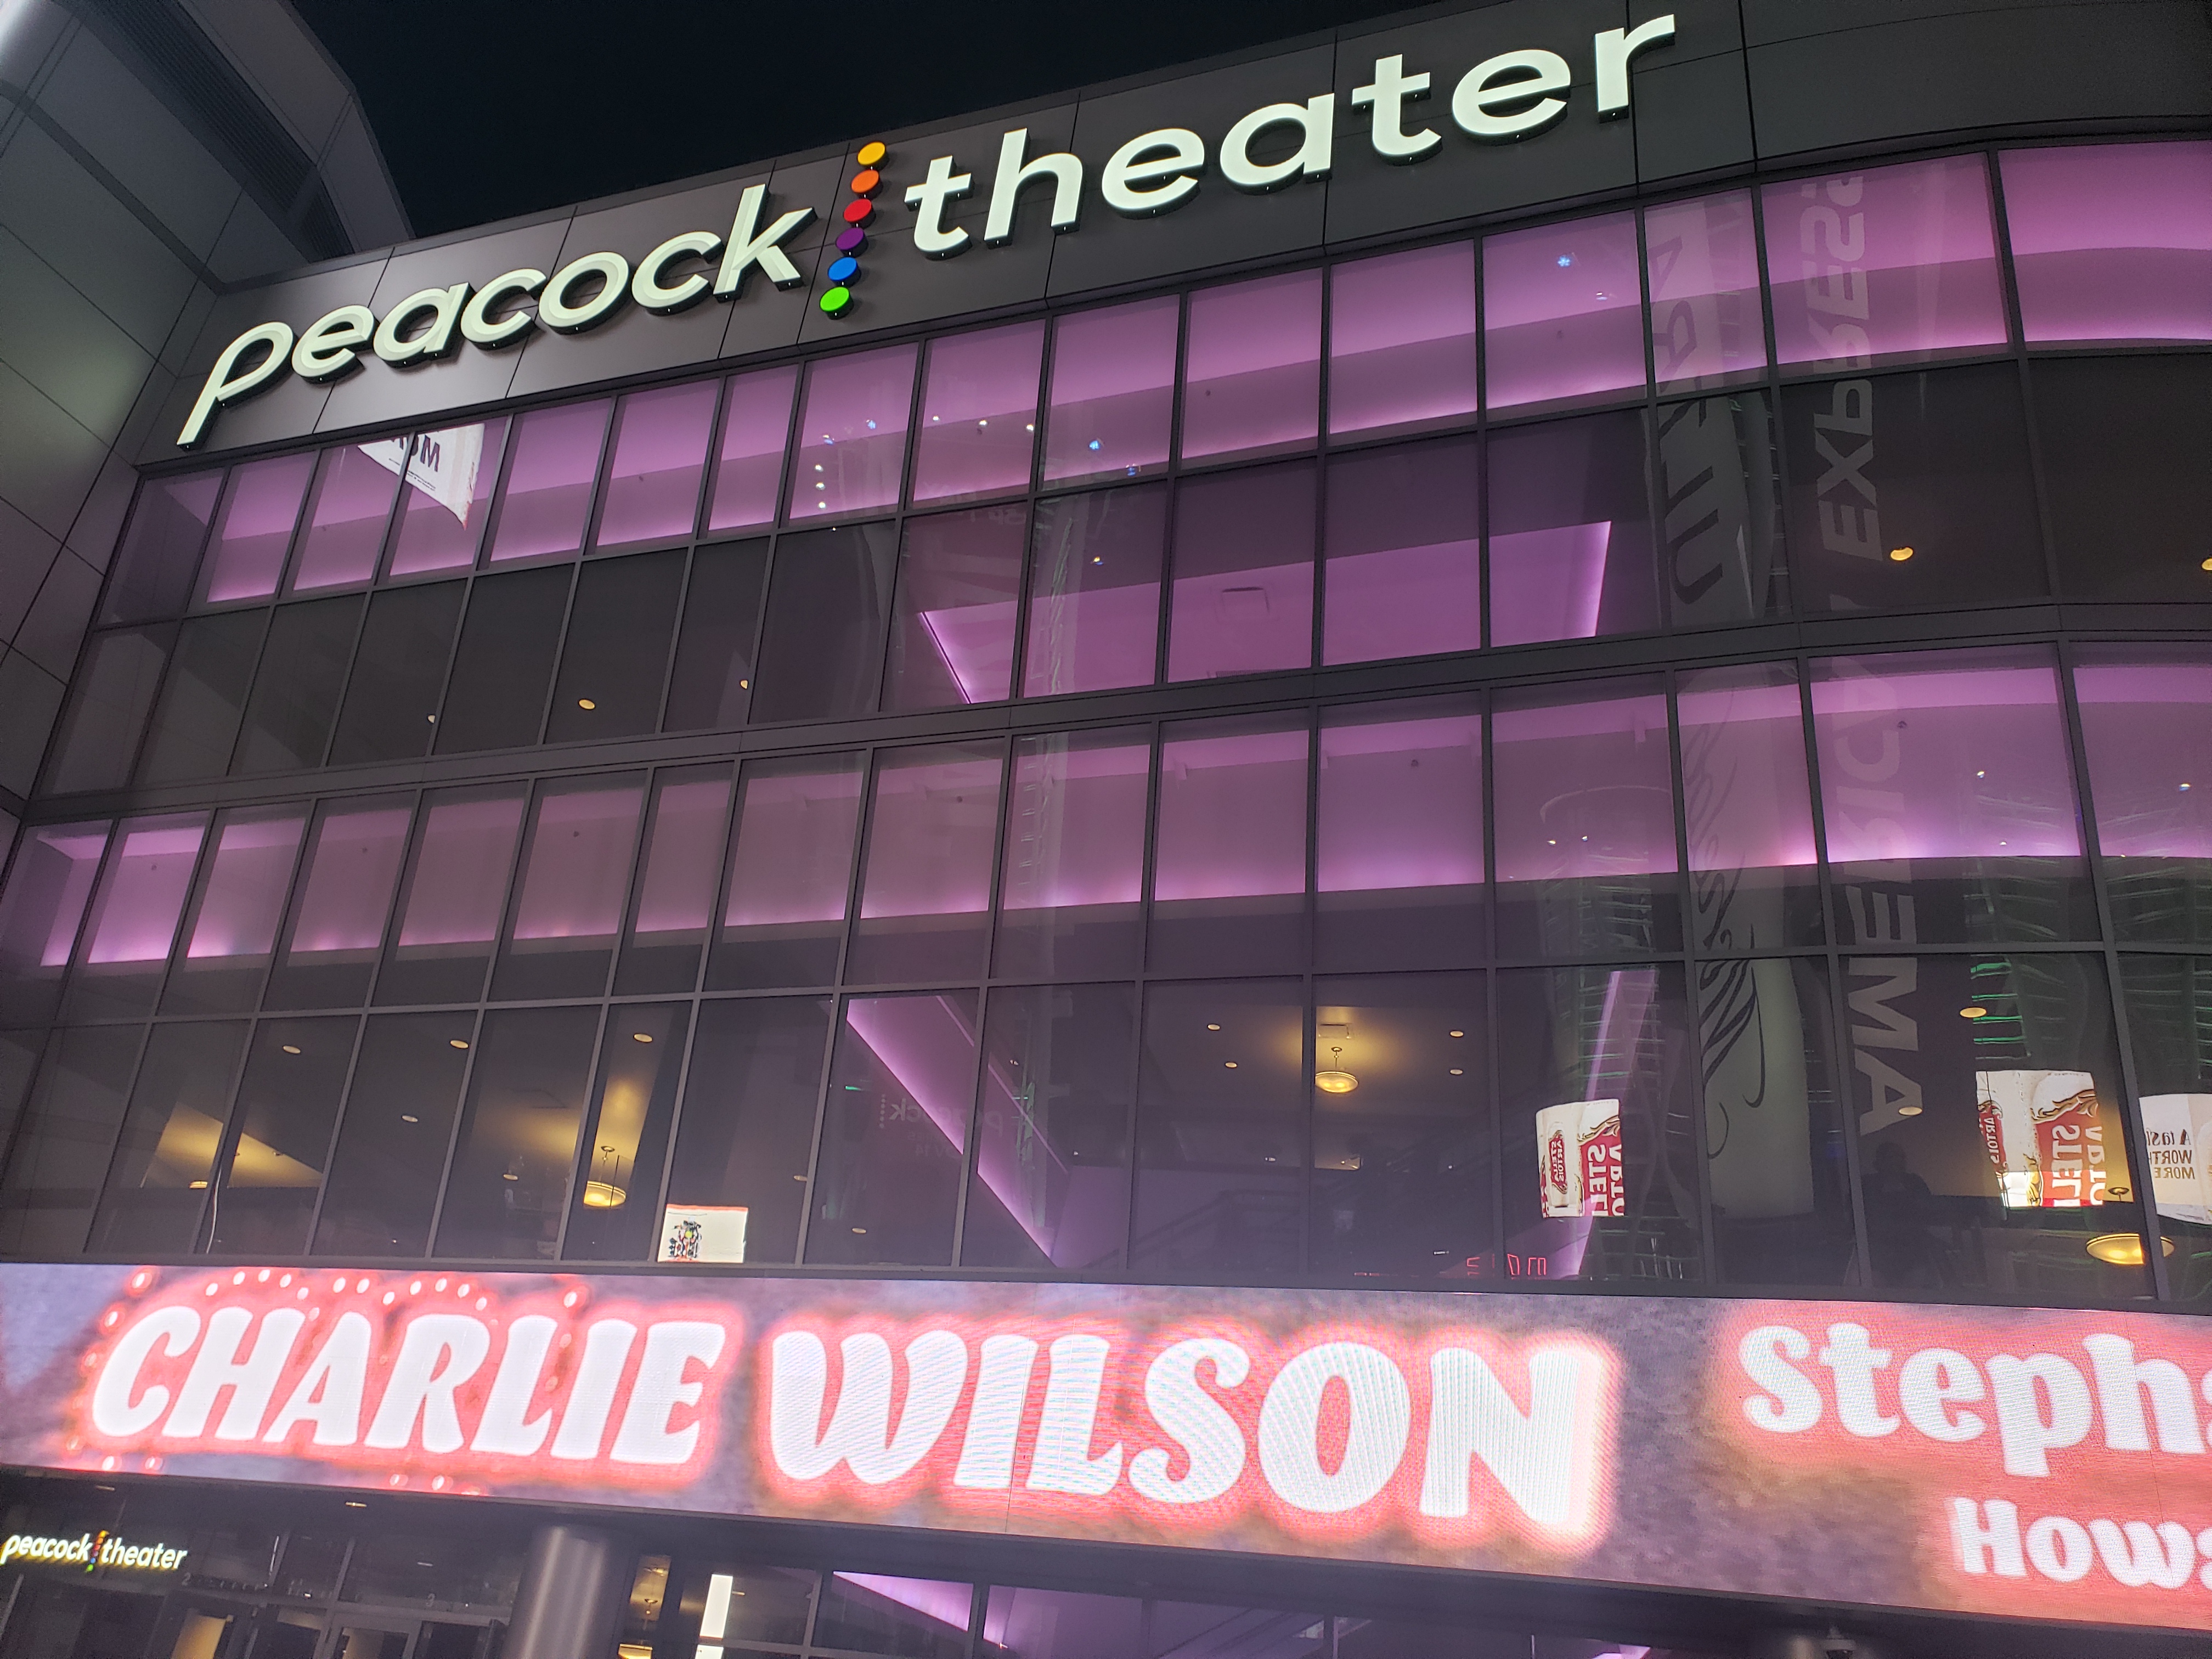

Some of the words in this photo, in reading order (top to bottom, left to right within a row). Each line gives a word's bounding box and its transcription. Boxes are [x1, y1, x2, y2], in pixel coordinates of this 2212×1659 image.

[178, 183, 816, 451] peacock
[905, 13, 1675, 261] theater
[92, 1306, 726, 1465] CHARLIE
[770, 1329, 1605, 1528] WILSON
[1739, 1321, 2212, 1477] Steph
[0, 1532, 92, 1565] peacock
[101, 1538, 188, 1570] theater
[1953, 1497, 2212, 1590] How
